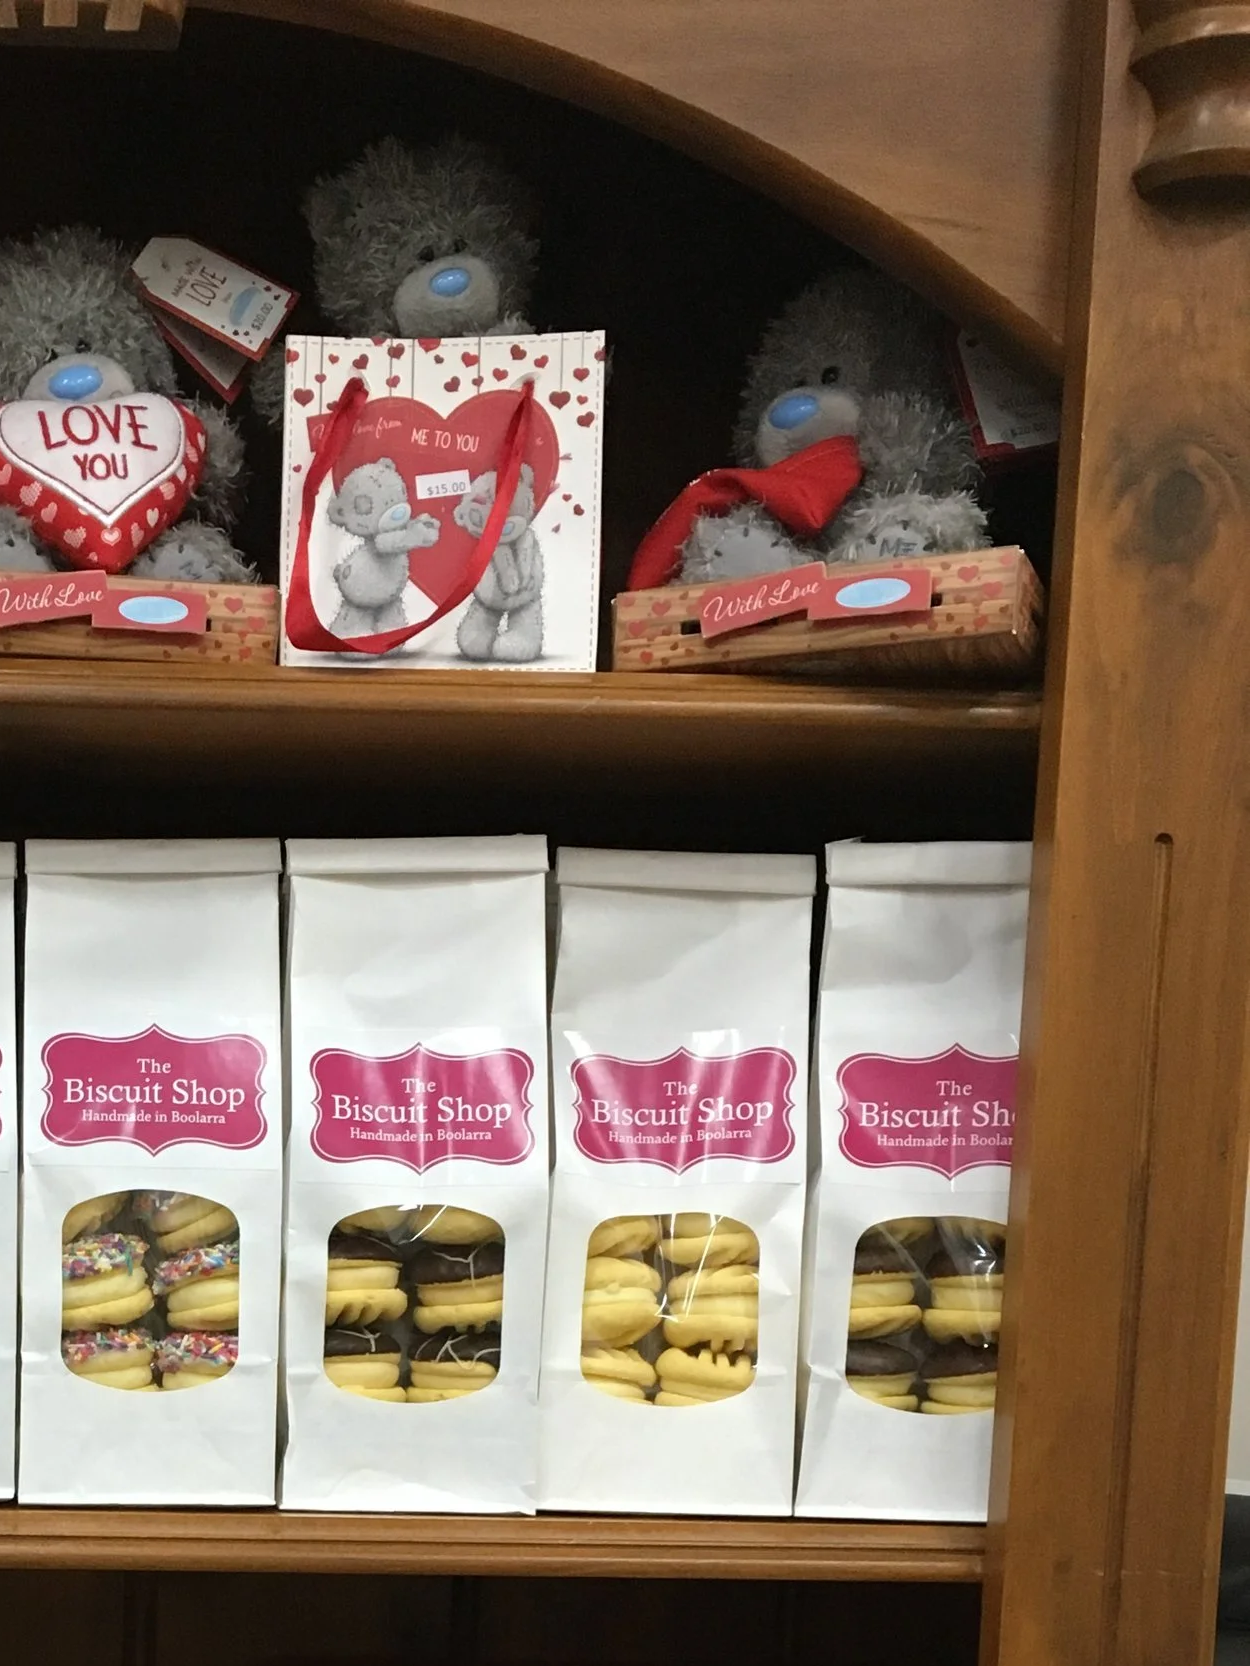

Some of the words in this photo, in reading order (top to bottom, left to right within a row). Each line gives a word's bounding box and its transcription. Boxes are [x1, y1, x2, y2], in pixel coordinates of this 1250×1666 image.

[186, 266, 227, 307] LOVE
[38, 404, 158, 451] LOVE
[411, 428, 429, 445] ME
[435, 430, 451, 449] TO
[456, 434, 479, 453] YOU
[73, 453, 128, 480] YOU
[426, 481, 467, 496] $15.00
[54, 583, 104, 606] Love
[703, 585, 764, 622] With
[768, 579, 821, 607] Love
[137, 1058, 171, 1074] The
[63, 1079, 162, 1105] Biscuit
[172, 1079, 245, 1112] Shop
[402, 1078, 436, 1094] The
[663, 1081, 698, 1096] The
[935, 1080, 972, 1097] The
[82, 1109, 151, 1124] Handmade
[154, 1110, 168, 1123] in
[171, 1110, 226, 1124] Boolarra
[331, 1095, 428, 1125] Biscuit
[437, 1097, 513, 1128] Shop
[591, 1099, 690, 1127] Biscuit
[697, 1098, 773, 1129] Shop
[859, 1101, 962, 1128] Biscuit
[350, 1127, 418, 1142] Handmade
[420, 1129, 434, 1142] in
[437, 1128, 492, 1142] Boolarra
[609, 1130, 677, 1144] Handmade
[680, 1132, 693, 1144] in
[697, 1127, 752, 1142] Boolarra
[877, 1134, 948, 1147] Handmade
[952, 1134, 966, 1146] in
